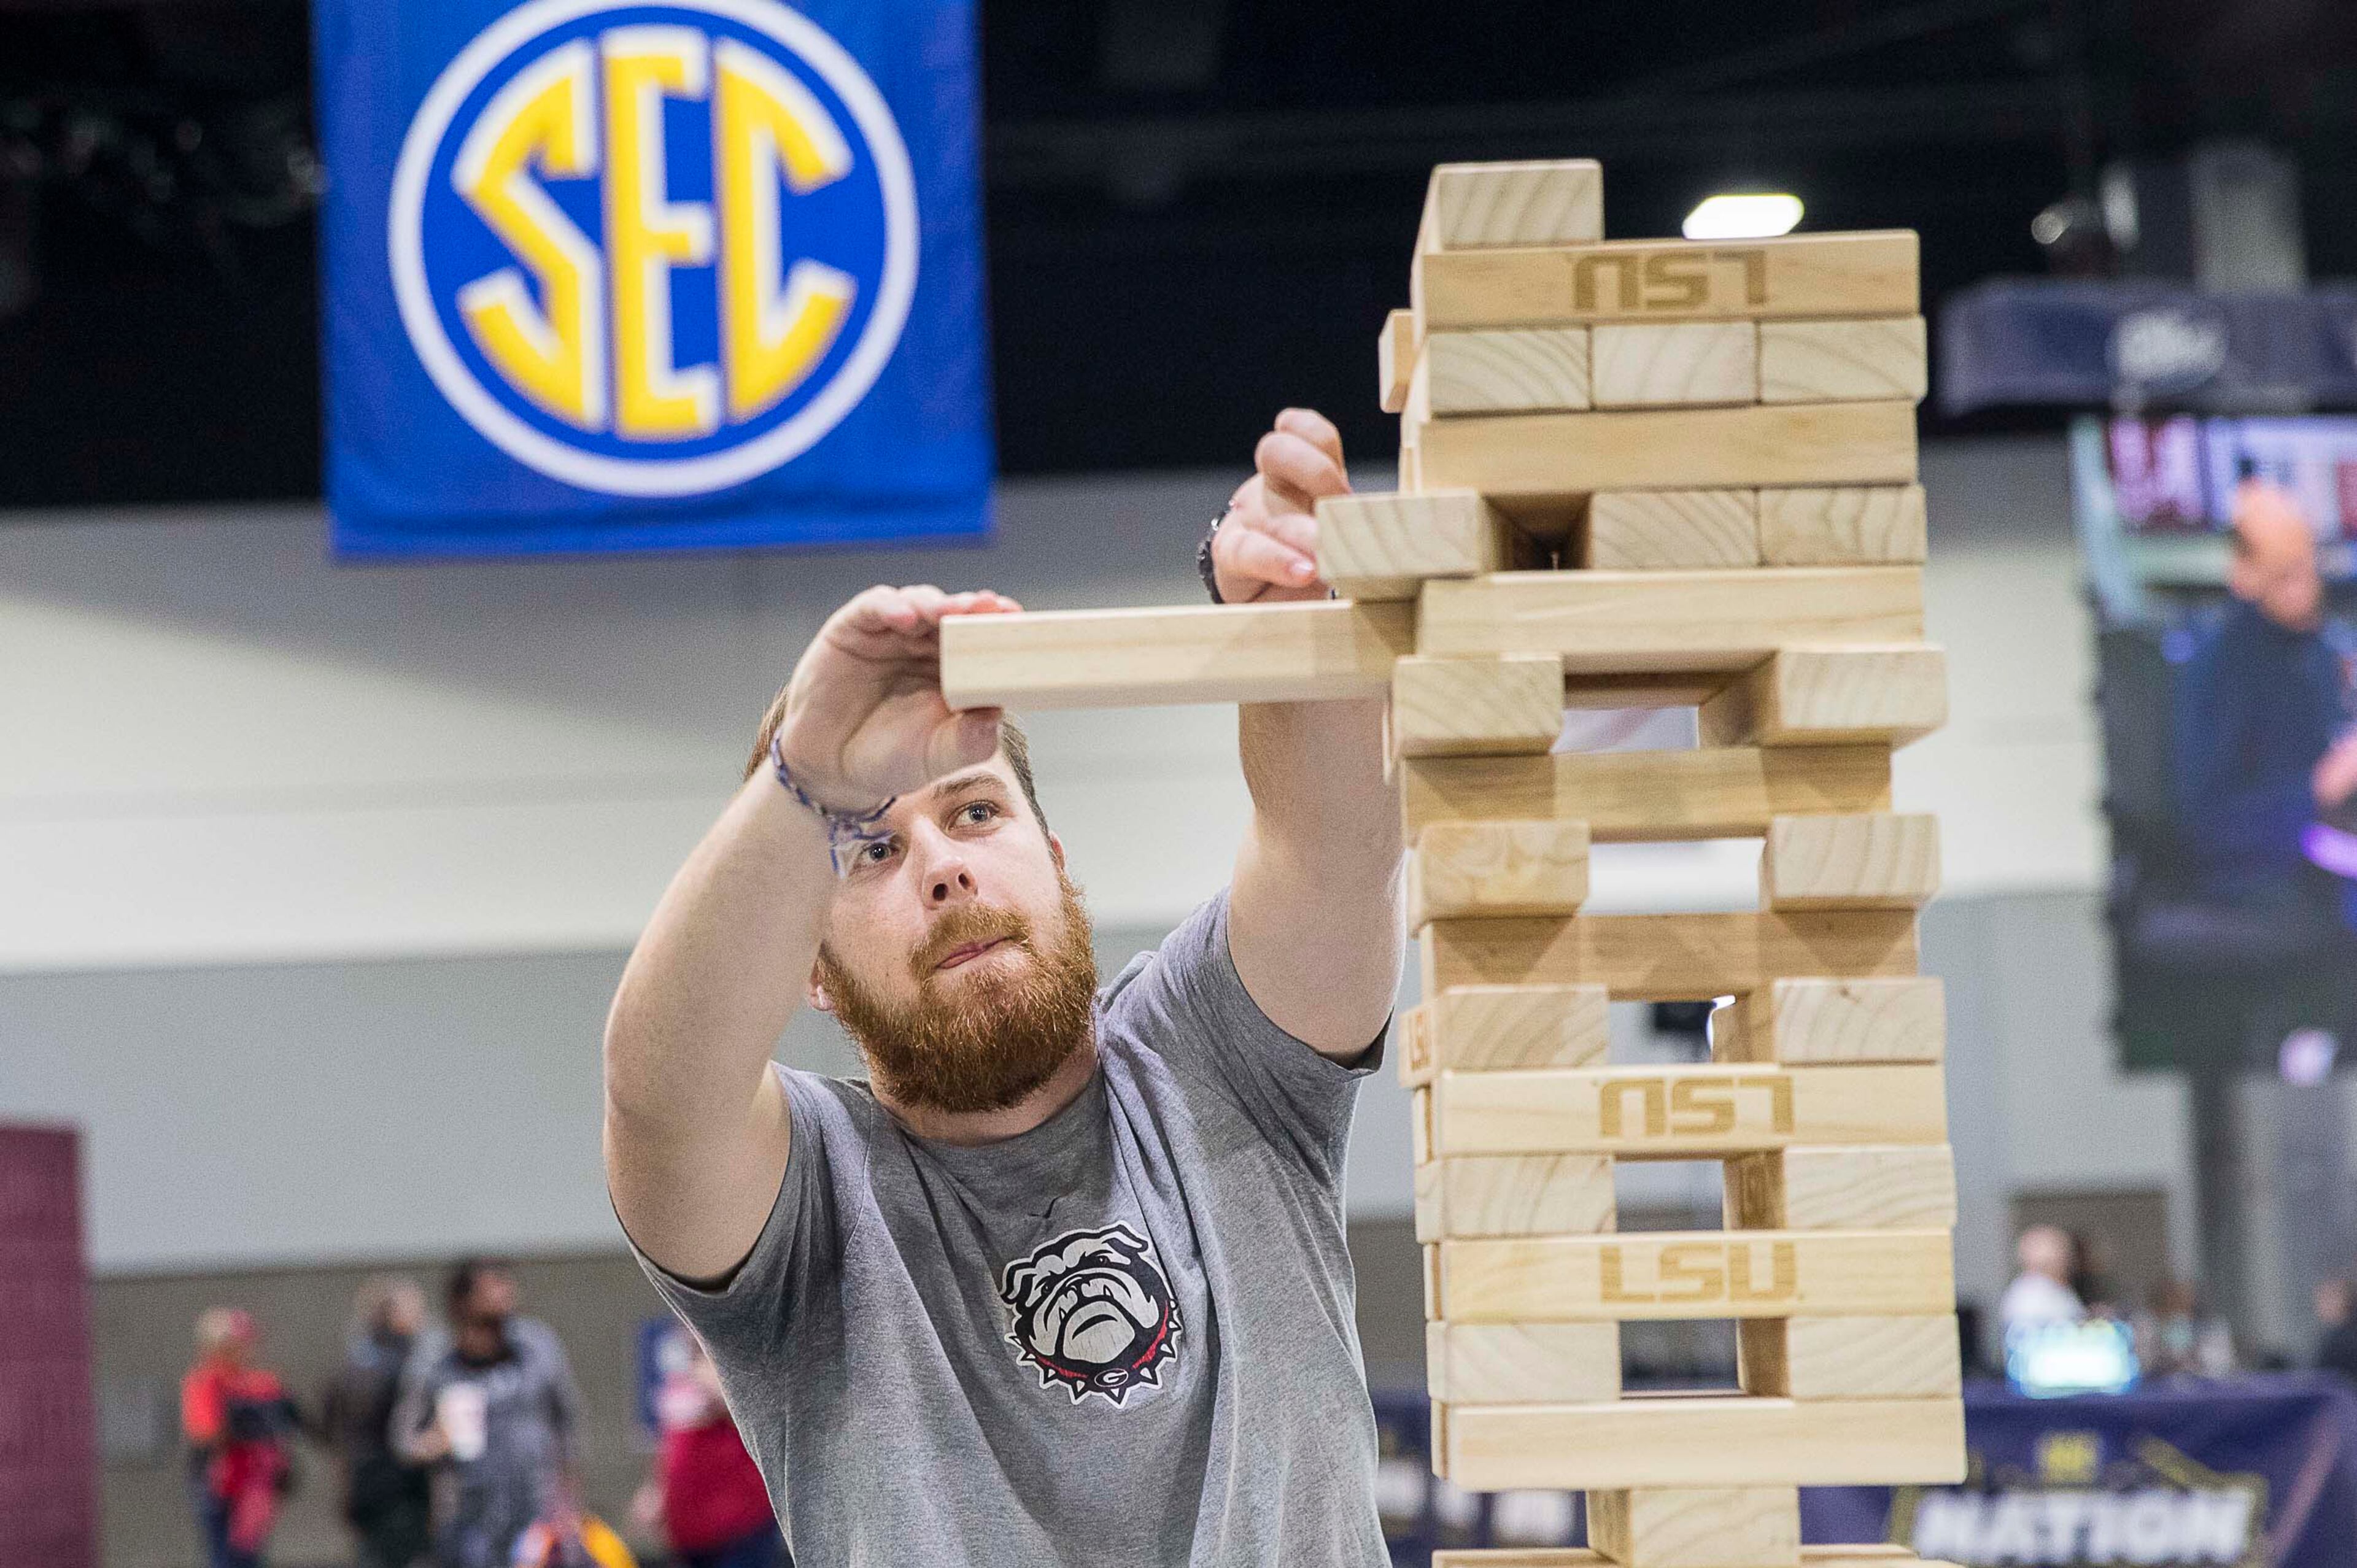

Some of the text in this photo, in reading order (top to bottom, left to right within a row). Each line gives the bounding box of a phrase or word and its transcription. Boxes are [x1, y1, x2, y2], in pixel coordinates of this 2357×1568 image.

[451, 22, 858, 441] SEC
[1573, 250, 1767, 308] LSU
[1600, 1076, 1794, 1137] LSU
[1600, 1243, 1796, 1303] LSU
